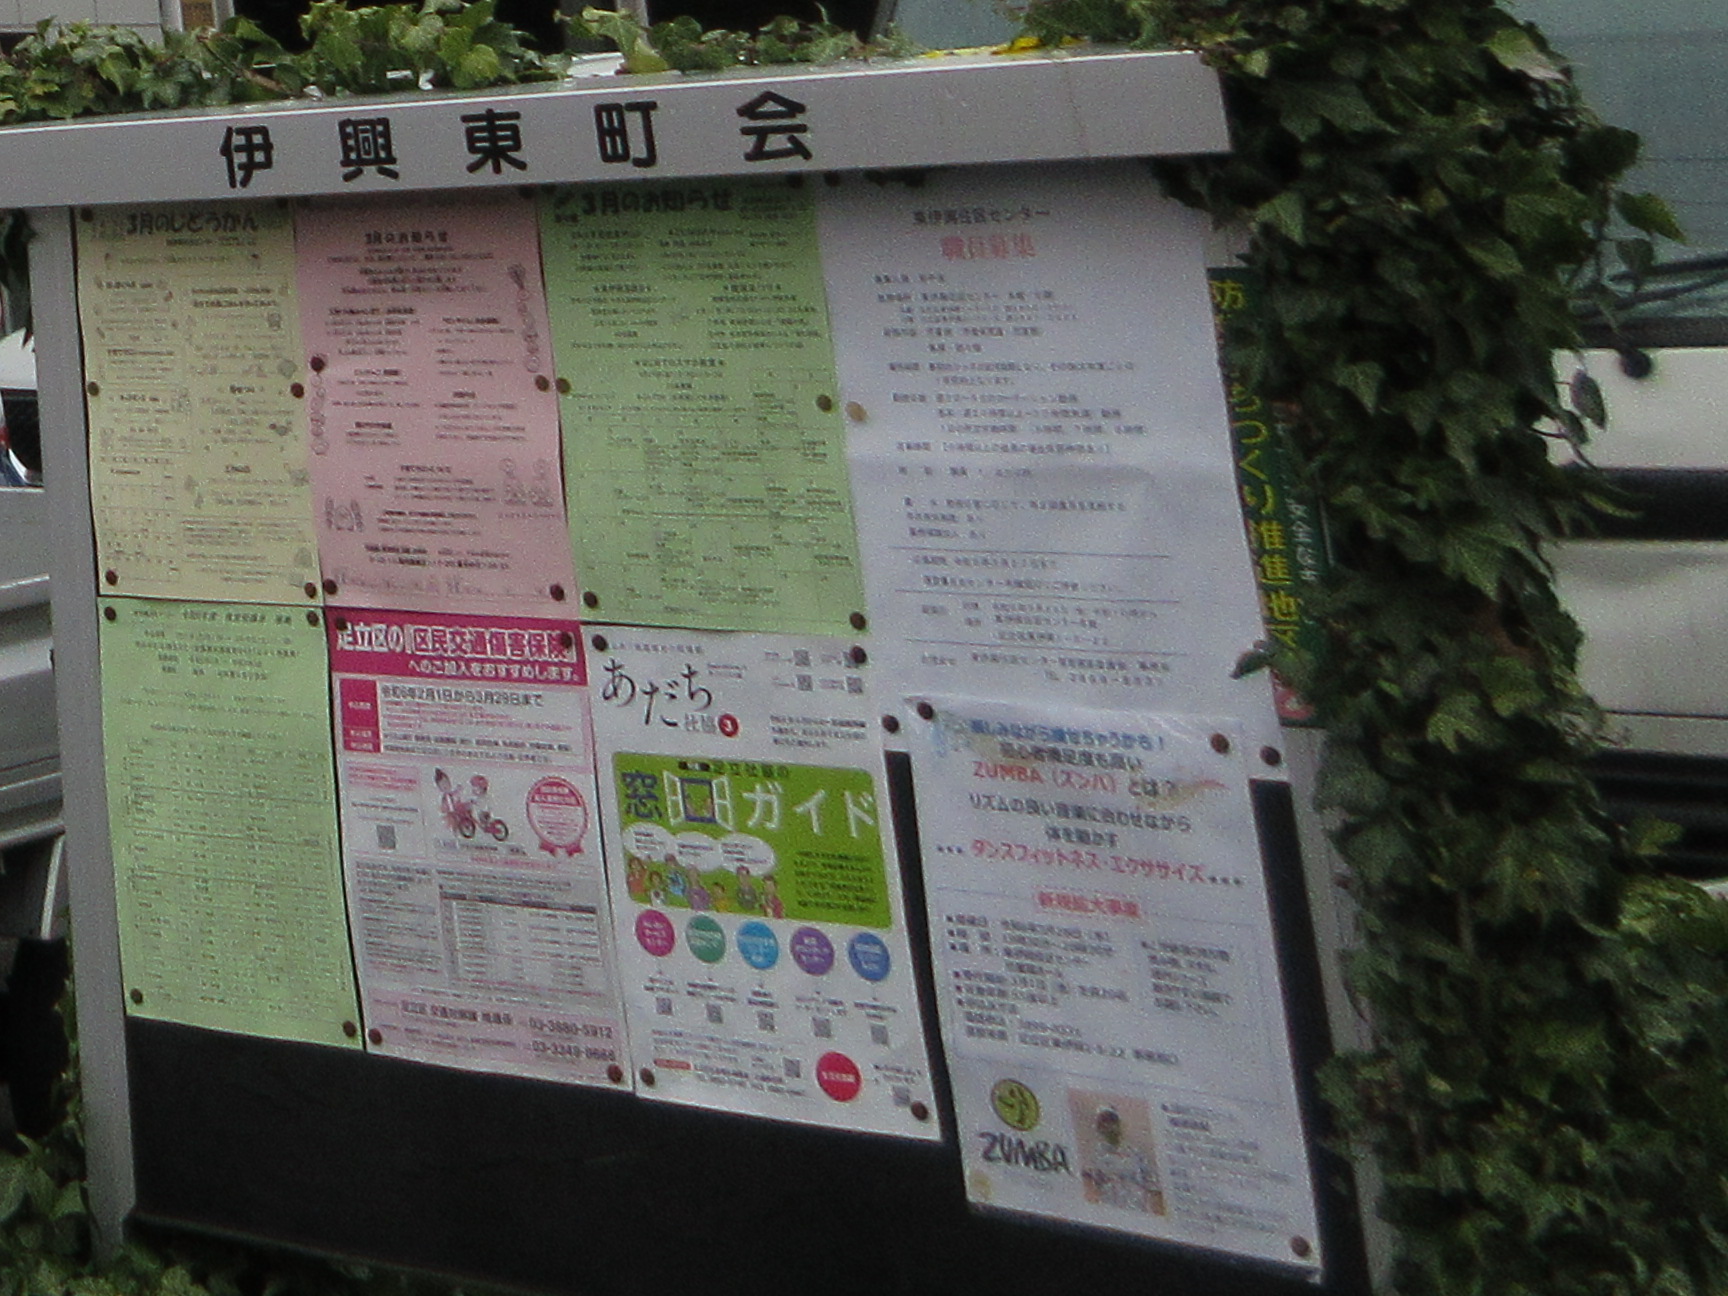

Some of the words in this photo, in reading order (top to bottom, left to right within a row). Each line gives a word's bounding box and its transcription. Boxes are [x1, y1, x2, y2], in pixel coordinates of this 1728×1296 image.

[220, 90, 813, 188] 伊興東町会
